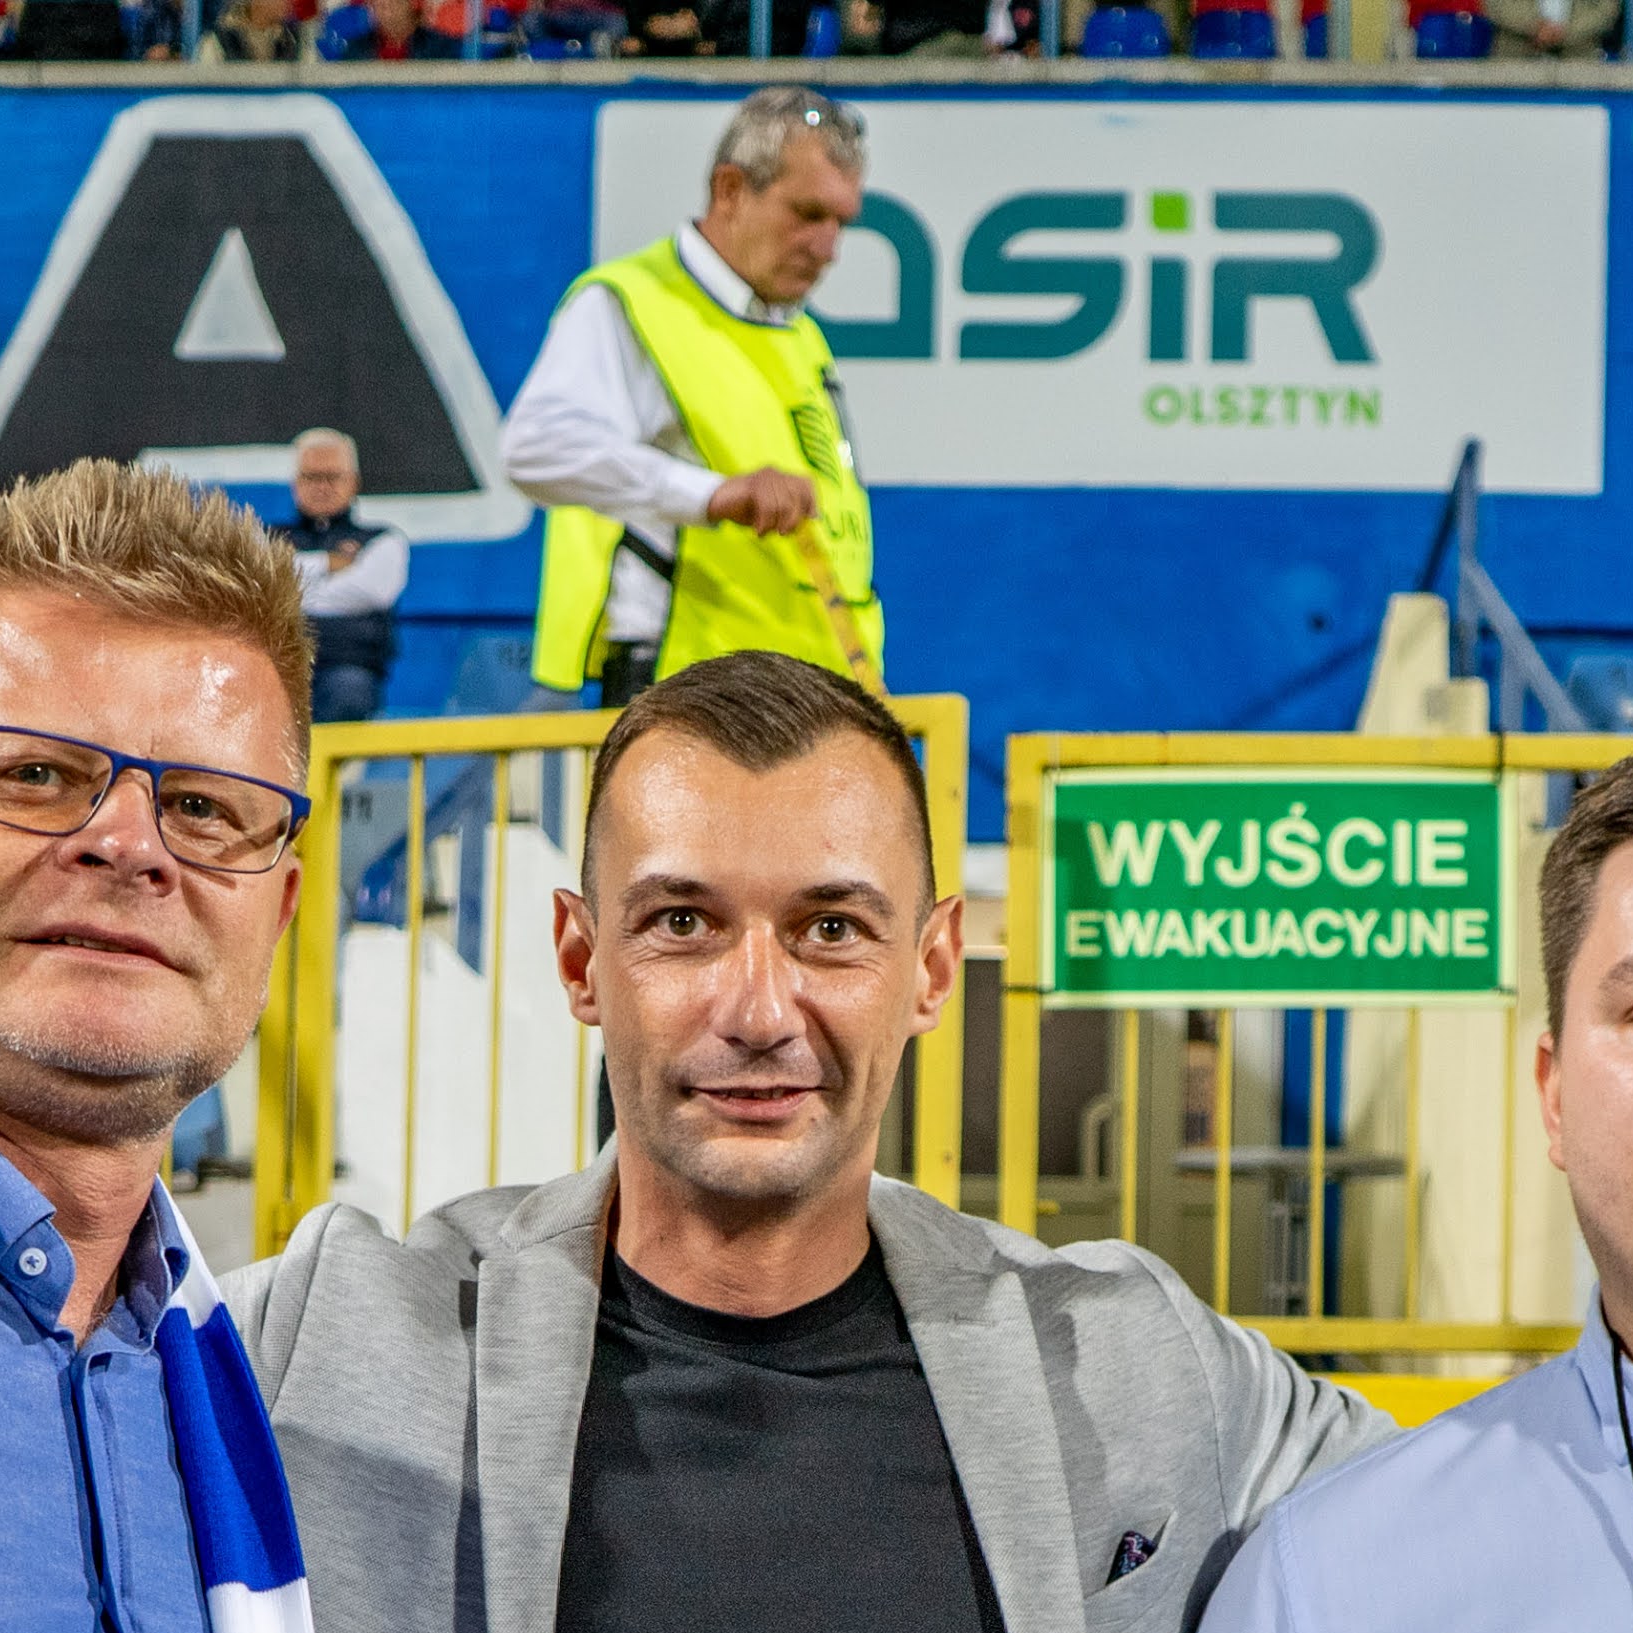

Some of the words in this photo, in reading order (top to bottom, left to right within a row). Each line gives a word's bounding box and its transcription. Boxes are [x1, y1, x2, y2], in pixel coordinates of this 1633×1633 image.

[1143, 385, 1383, 428] OLSZTYN
[1087, 802, 1469, 887] WYJŚCIE
[1067, 908, 1490, 960] EWAKUACYJNE
